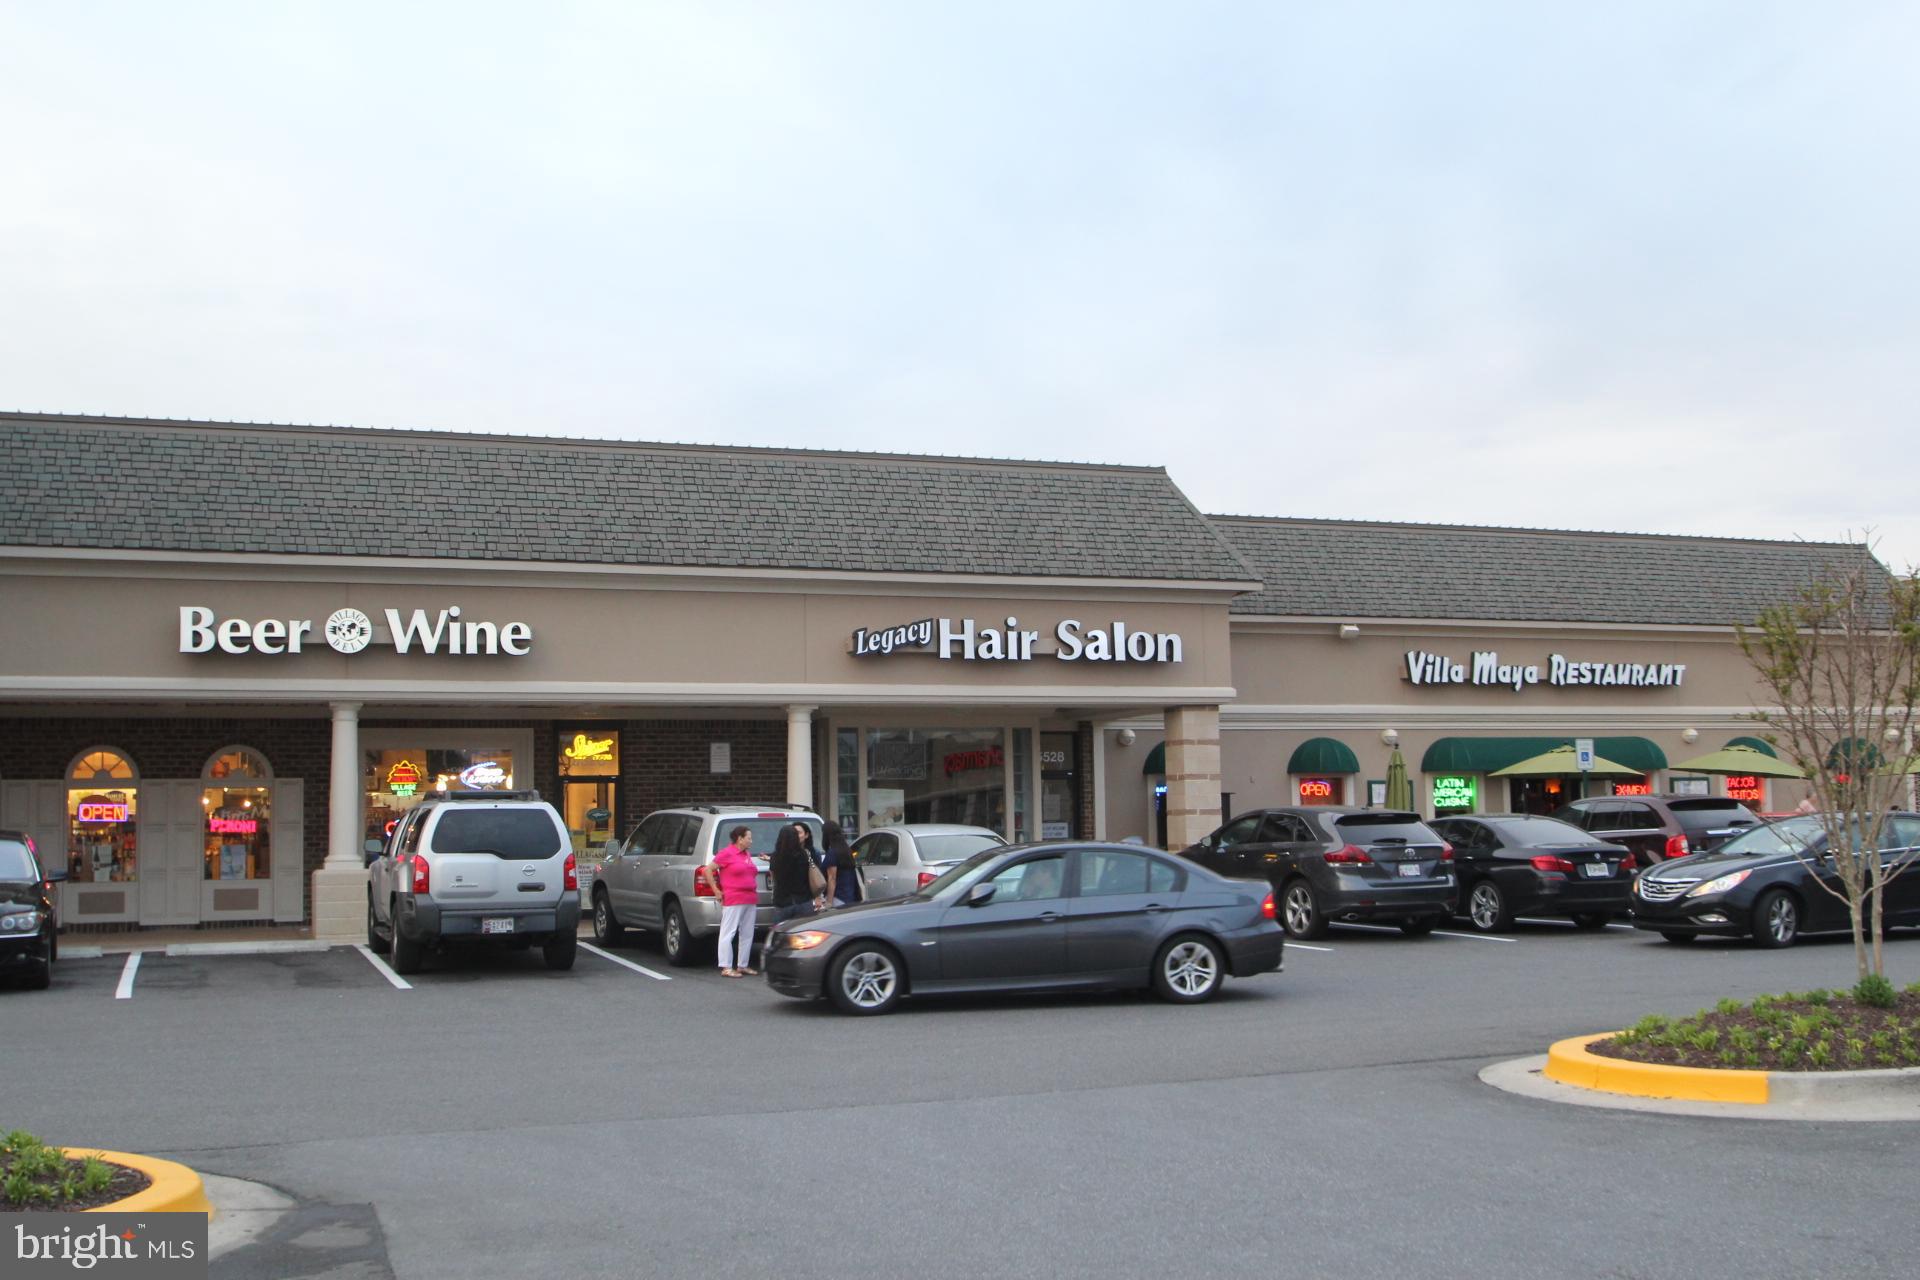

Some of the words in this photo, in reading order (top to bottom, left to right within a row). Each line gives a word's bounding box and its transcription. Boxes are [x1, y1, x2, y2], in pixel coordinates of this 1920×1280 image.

[330, 610, 369, 625] VILLAGE
[179, 606, 312, 654] Beer
[384, 605, 532, 656] Wine
[332, 638, 365, 651] DELI
[854, 619, 934, 655] Legacy
[939, 616, 1038, 660] Hair
[1056, 619, 1182, 662] Salon
[1405, 650, 1464, 685] Villa
[1472, 651, 1539, 692] Maya
[1550, 653, 1686, 686] RESTAURANT
[1436, 778, 1464, 788] LATIN
[1726, 776, 1755, 788] TACOS
[1300, 783, 1329, 796] OPEN
[1433, 797, 1470, 807] CUISINE
[82, 806, 124, 820] OPEN
[210, 818, 256, 833] PERONI
